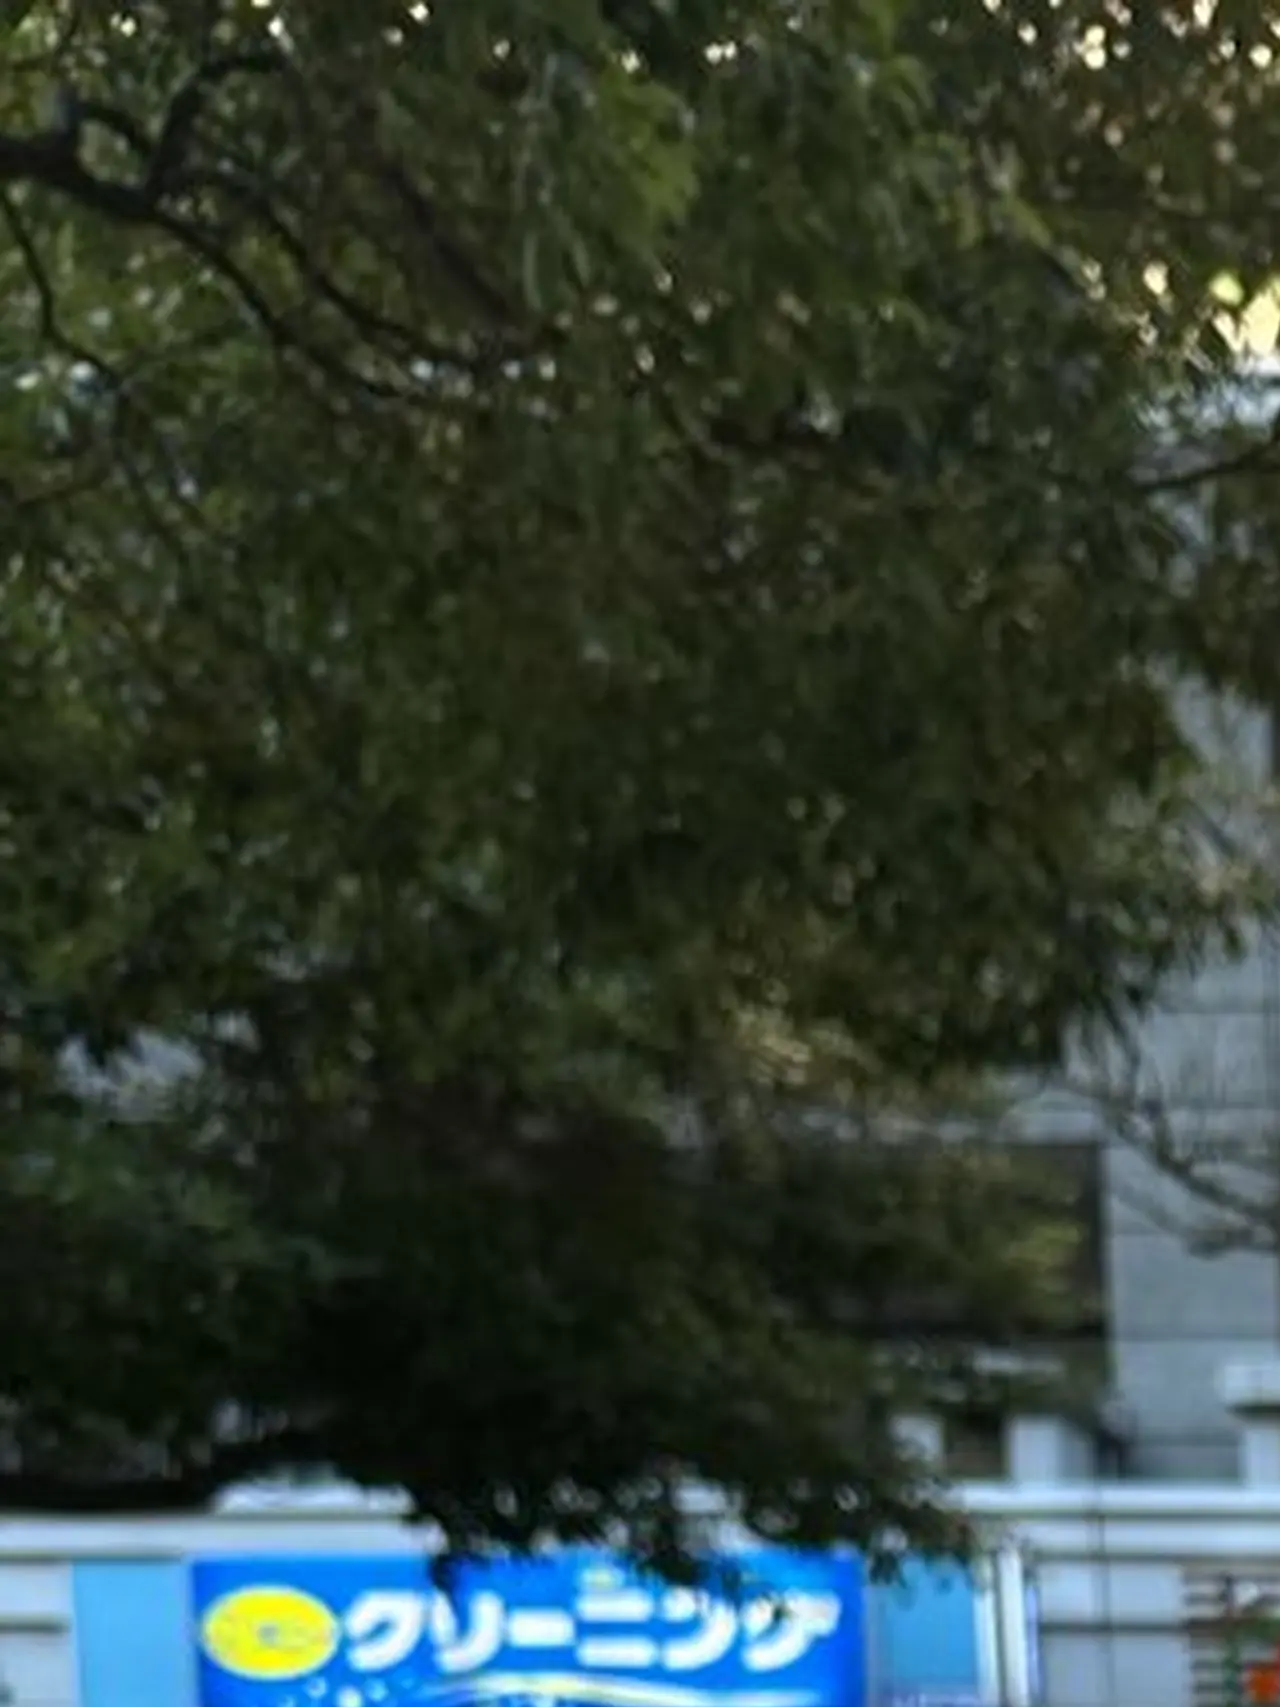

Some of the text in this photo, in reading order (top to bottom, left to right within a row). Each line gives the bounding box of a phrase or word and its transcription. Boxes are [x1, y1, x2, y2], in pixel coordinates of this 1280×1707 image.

[344, 1588, 842, 1673] クリーニング
